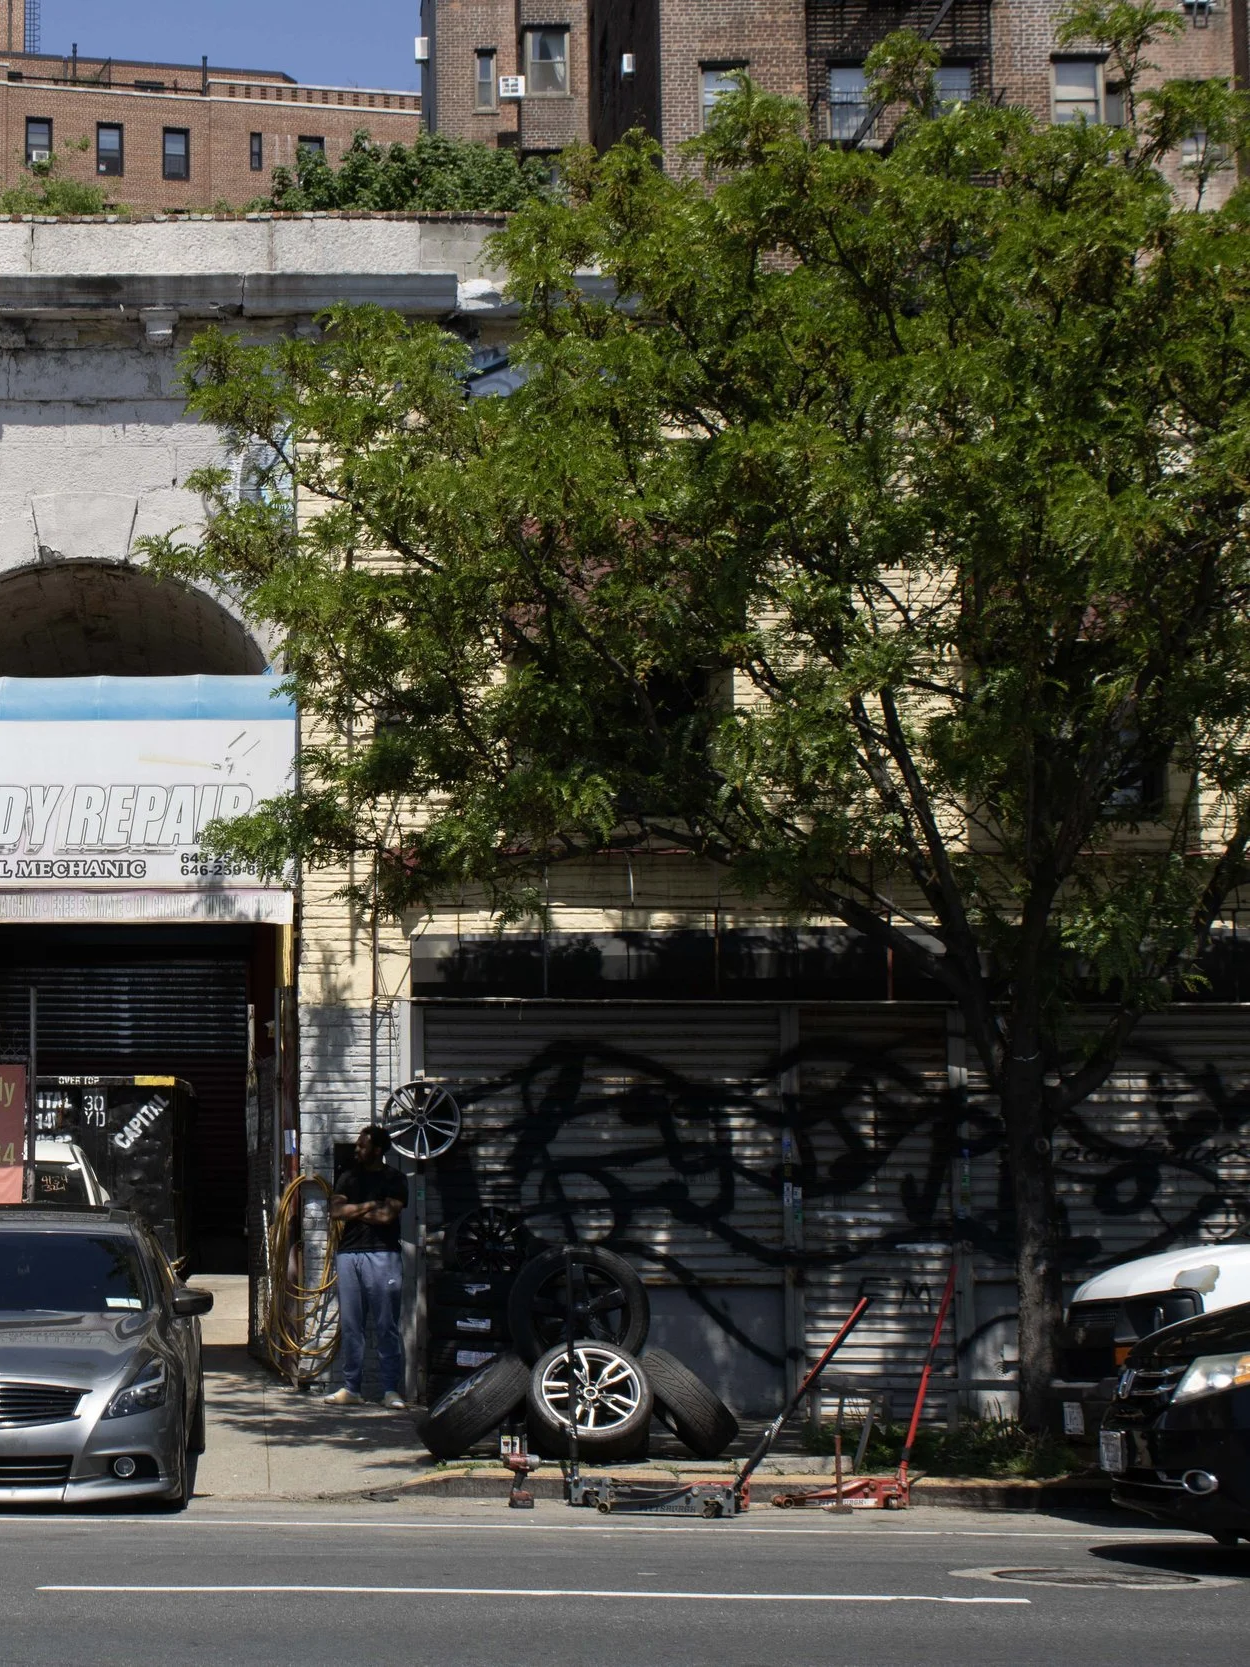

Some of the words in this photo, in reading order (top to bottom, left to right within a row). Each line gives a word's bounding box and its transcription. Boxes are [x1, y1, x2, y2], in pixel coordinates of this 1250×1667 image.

[15, 859, 147, 879] MECHANIC
[51, 894, 76, 918] FREE
[77, 894, 124, 918] ESTIMATE
[133, 894, 151, 918] OIL
[152, 894, 191, 918] CHANGE
[58, 1076, 81, 1085] OVER
[83, 1076, 100, 1085] TOP
[36, 1092, 73, 1109] ITAL
[84, 1095, 104, 1111] 30
[84, 1111, 106, 1127] YD
[114, 1094, 170, 1149] CAPITAL
